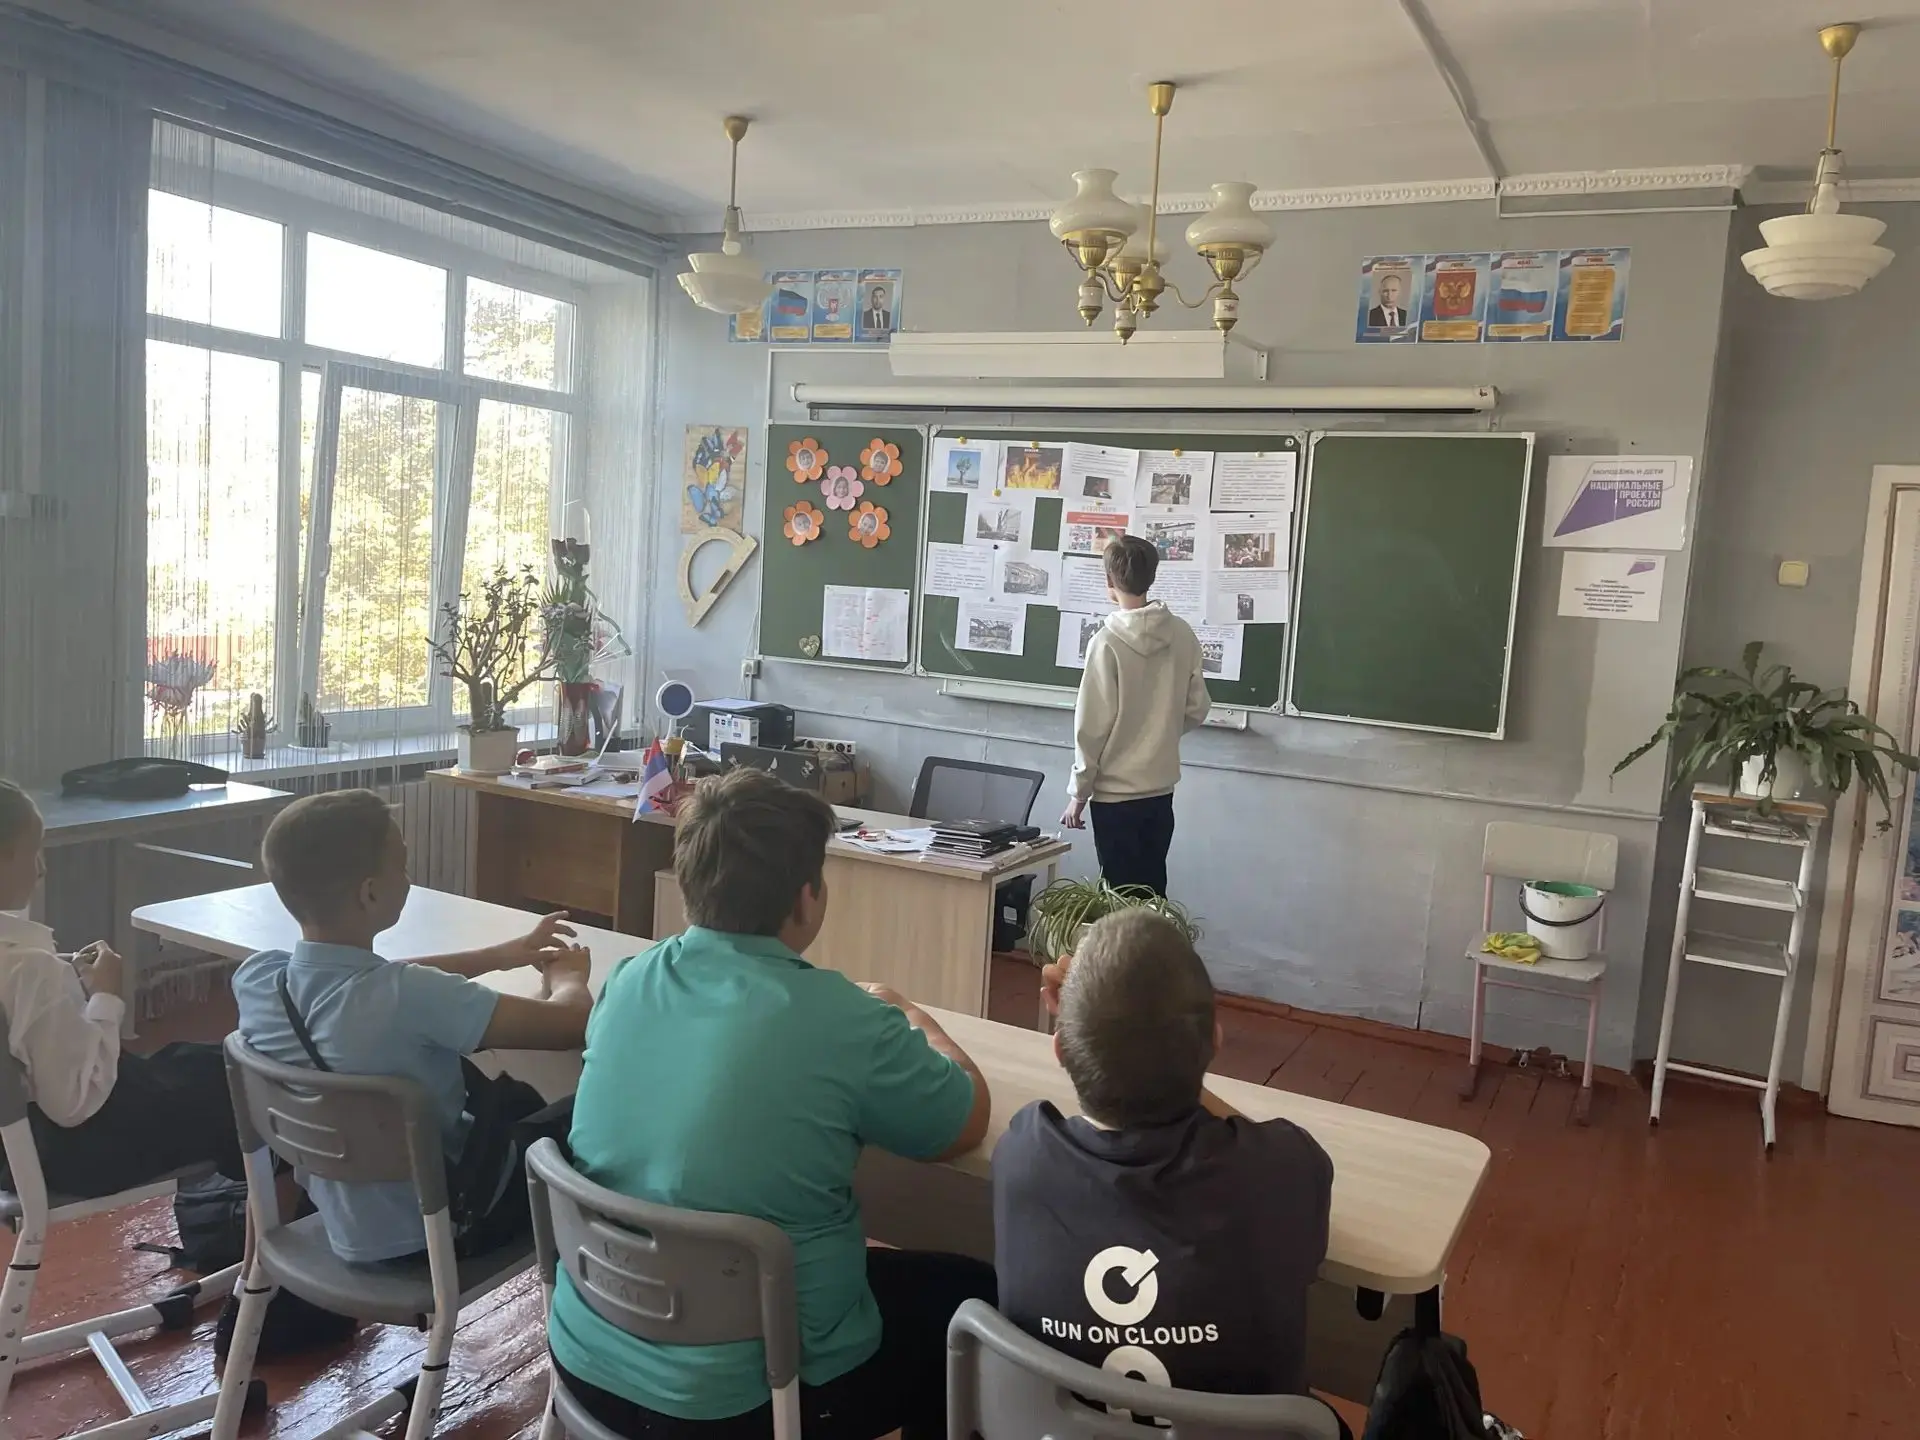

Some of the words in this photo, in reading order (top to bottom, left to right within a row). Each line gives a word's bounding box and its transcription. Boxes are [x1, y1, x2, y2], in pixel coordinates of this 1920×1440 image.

[1590, 481, 1661, 490] НАЦИОНАЛЬНЫЕ
[1620, 490, 1661, 499] ПРОЕКТЫ
[1625, 498, 1660, 508] РОССИИ
[1041, 1316, 1082, 1341] RUN
[1088, 1325, 1120, 1345] ON
[1124, 1323, 1219, 1345] CLOUDS
